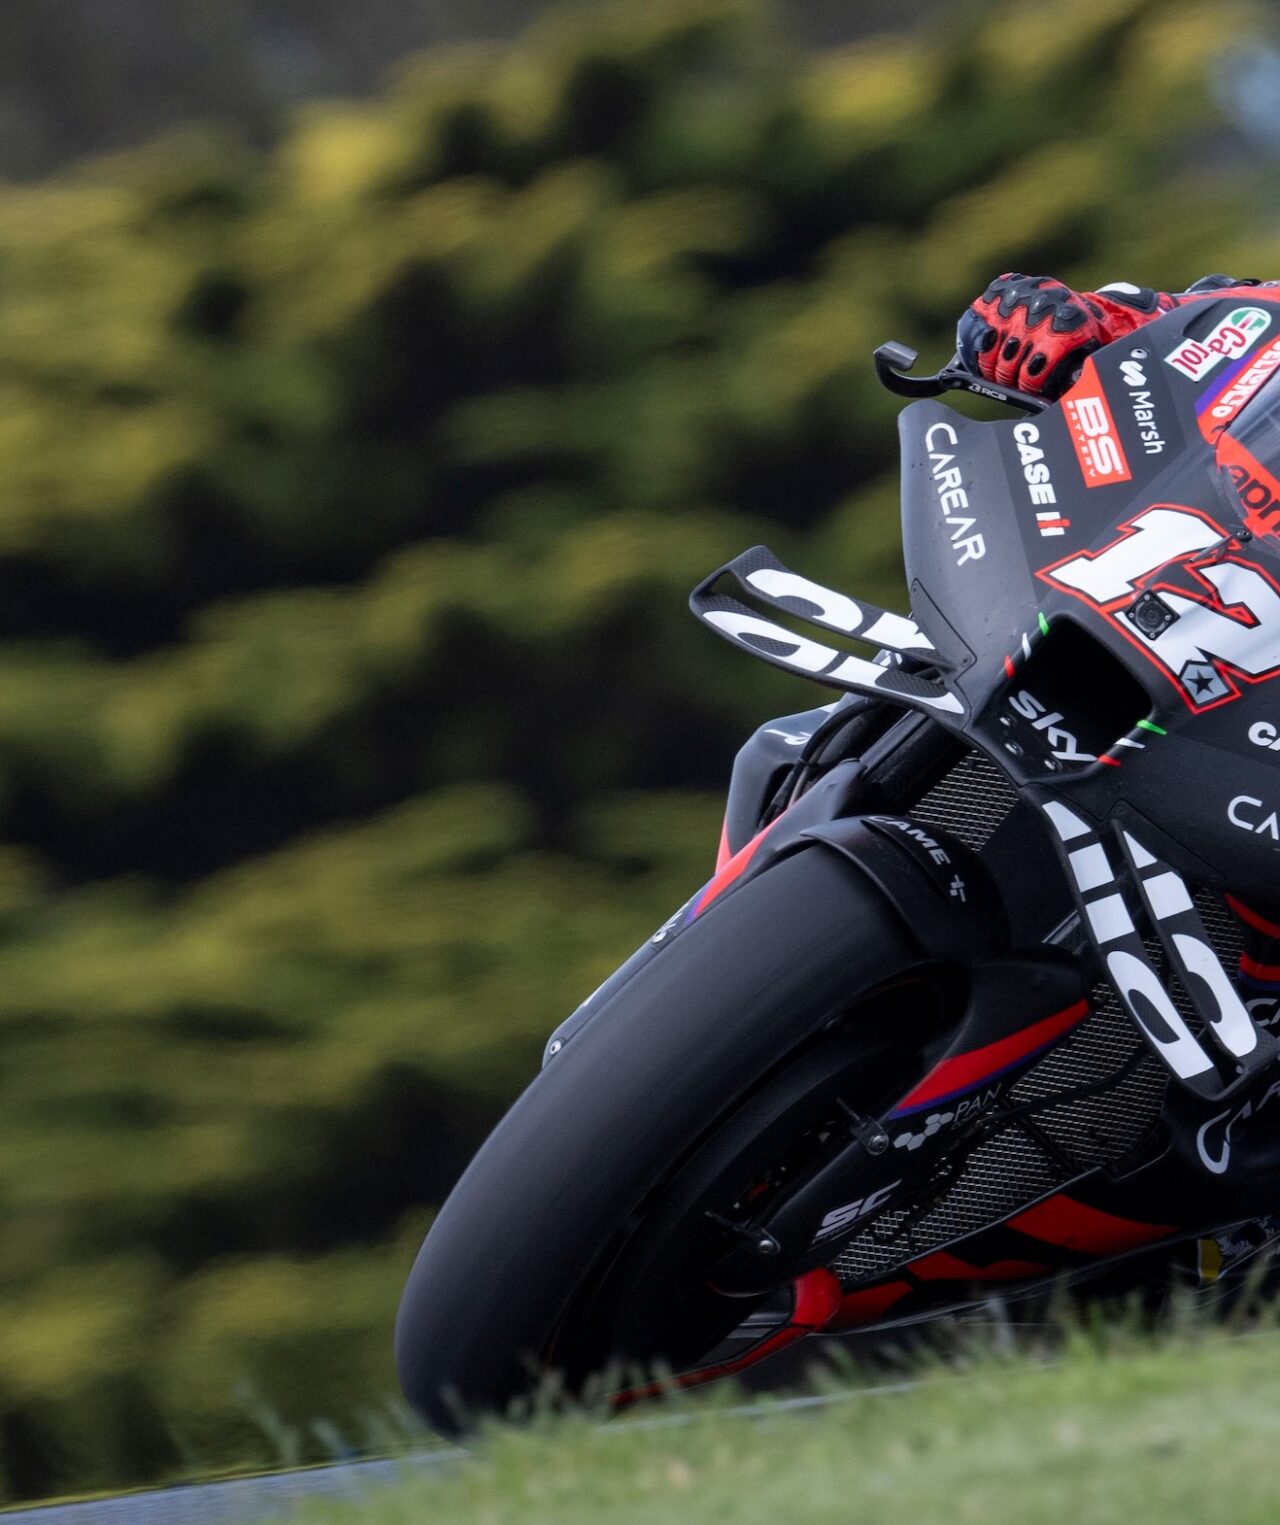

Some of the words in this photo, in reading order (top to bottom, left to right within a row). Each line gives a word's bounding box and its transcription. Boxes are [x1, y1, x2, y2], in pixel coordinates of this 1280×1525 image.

[1066, 400, 1096, 477] BATTERY
[1074, 396, 1123, 475] BS
[1129, 390, 1163, 455] Marsh
[925, 422, 986, 567] CAREAR
[1013, 422, 1057, 505] CASE
[1009, 690, 1099, 761] sky
[868, 816, 951, 865] CAME
